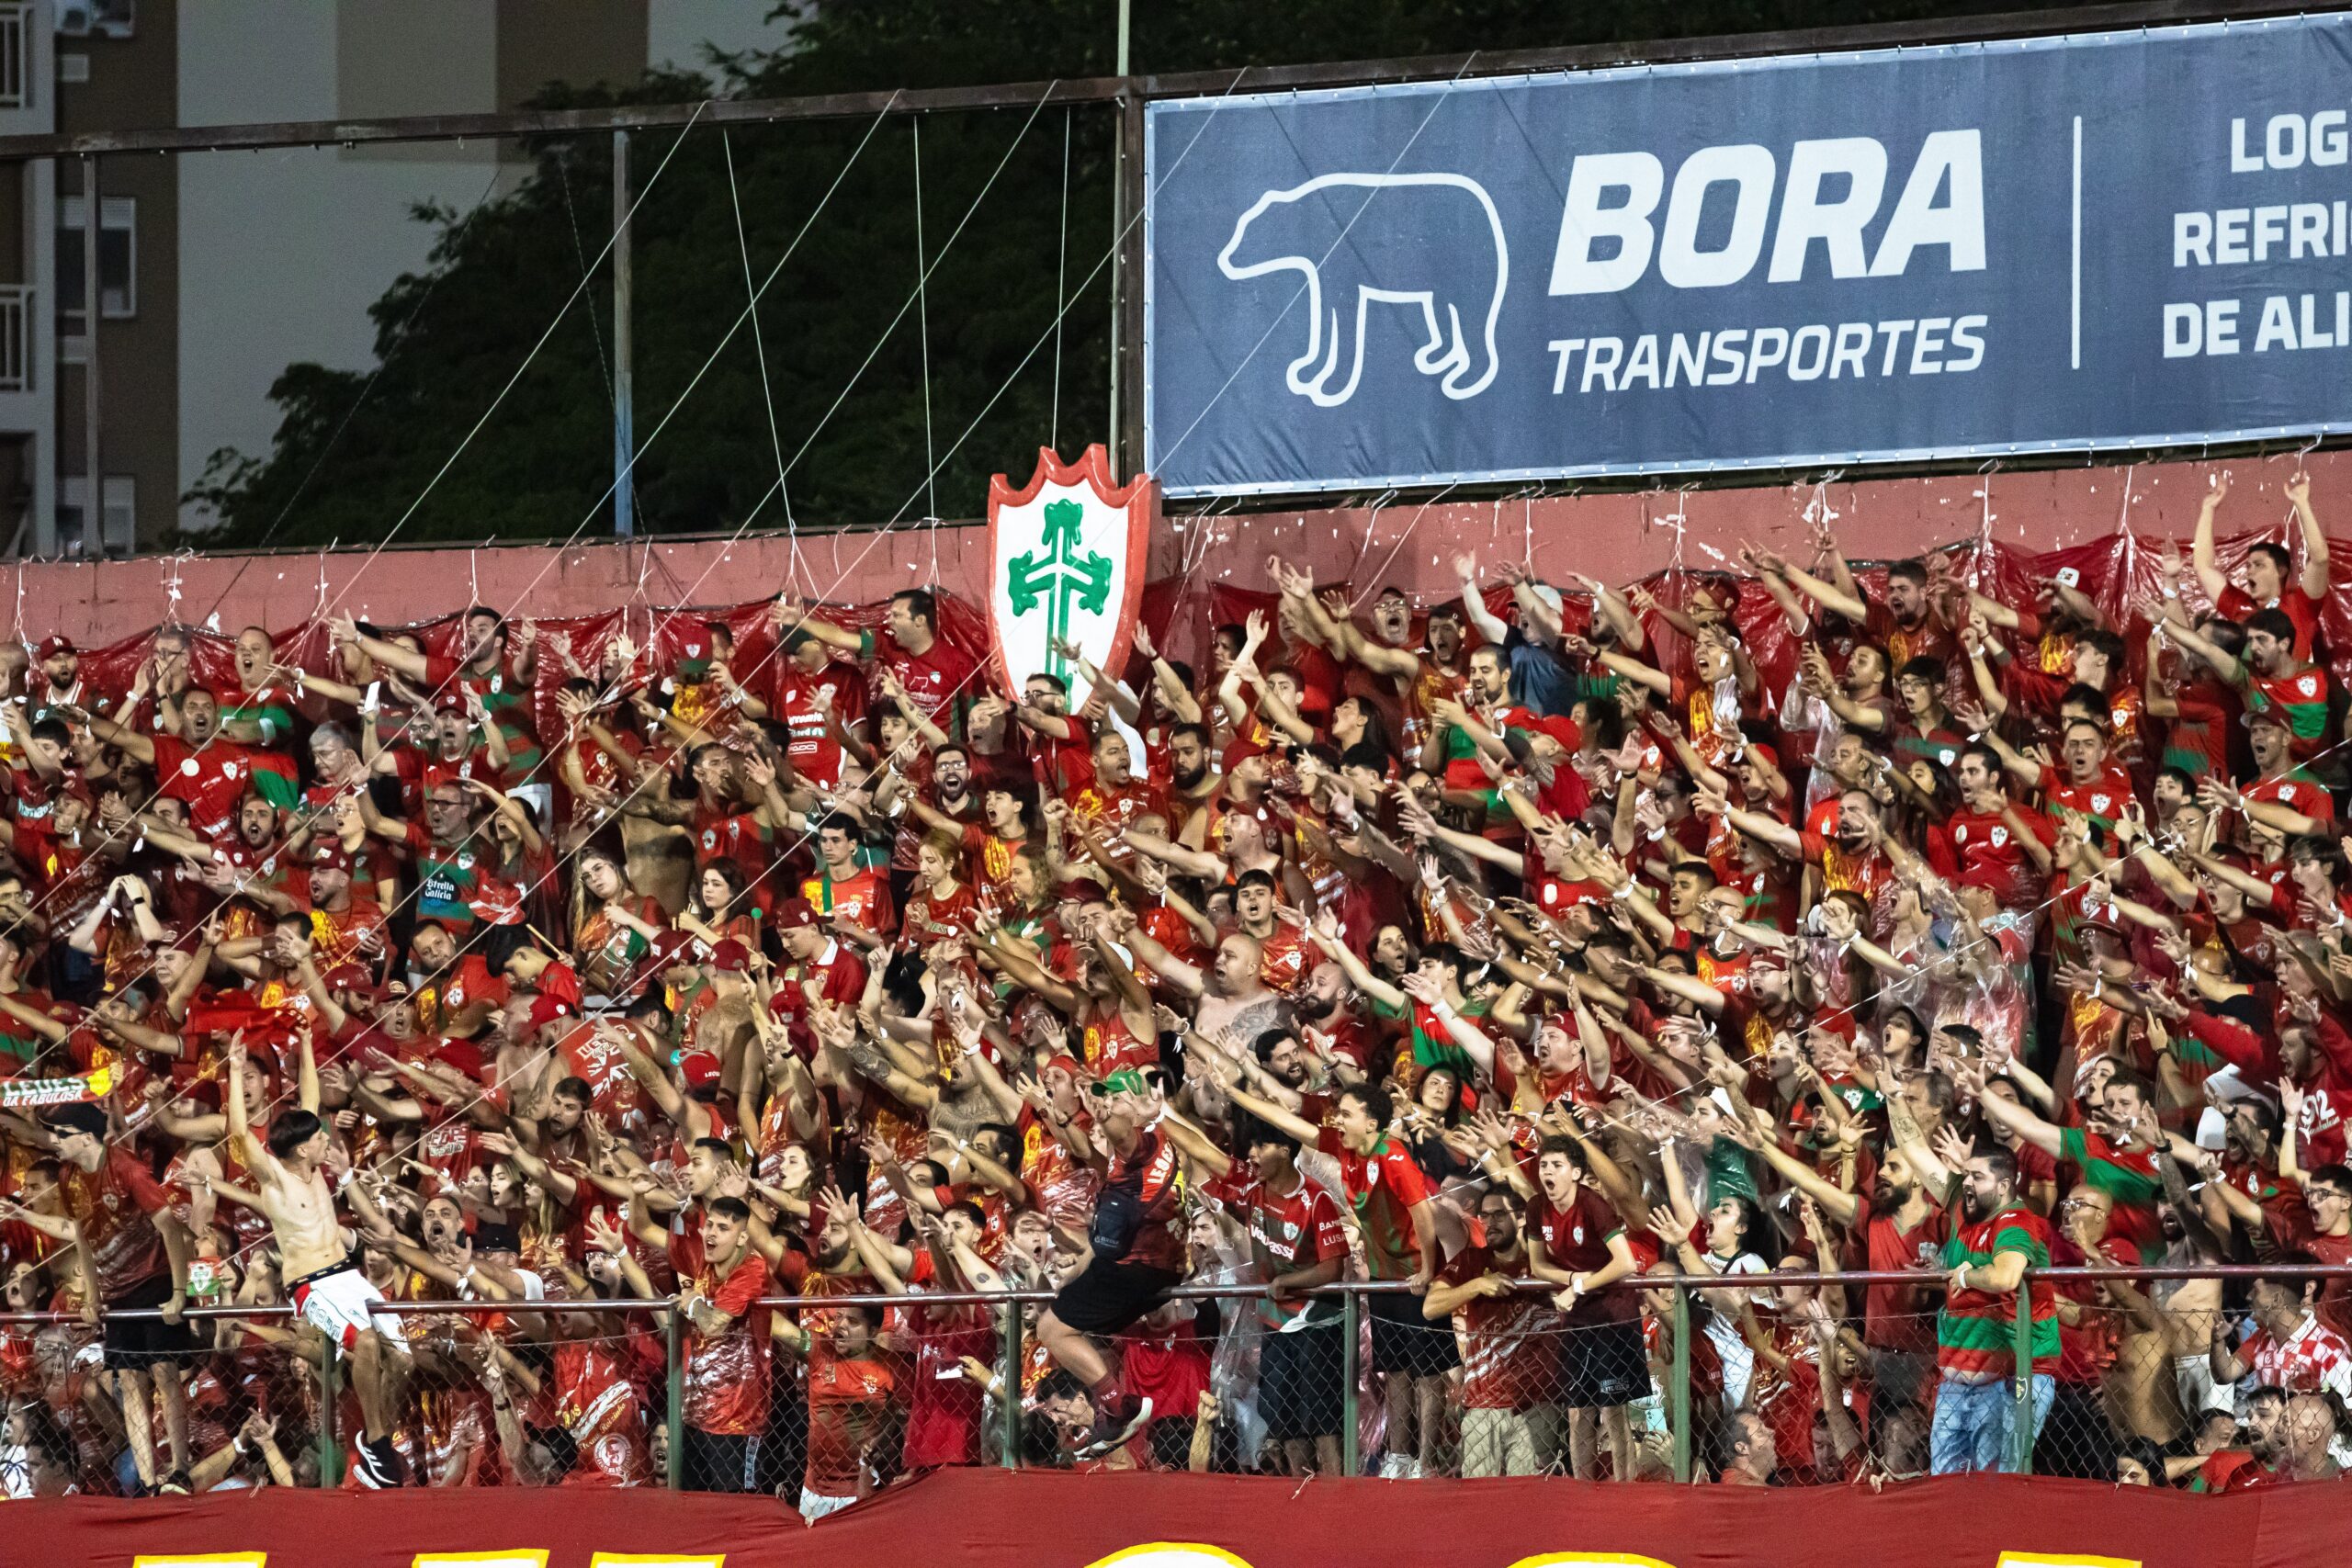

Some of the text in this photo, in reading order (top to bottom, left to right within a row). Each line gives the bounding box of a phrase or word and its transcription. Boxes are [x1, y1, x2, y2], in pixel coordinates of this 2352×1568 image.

[2231, 110, 2350, 173] LOG
[1548, 130, 1987, 297] BORA
[2174, 200, 2352, 267] REFRI
[1547, 315, 1988, 394] TRANSPORTES
[2163, 299, 2240, 359] DE
[2301, 1089, 2336, 1126] 92
